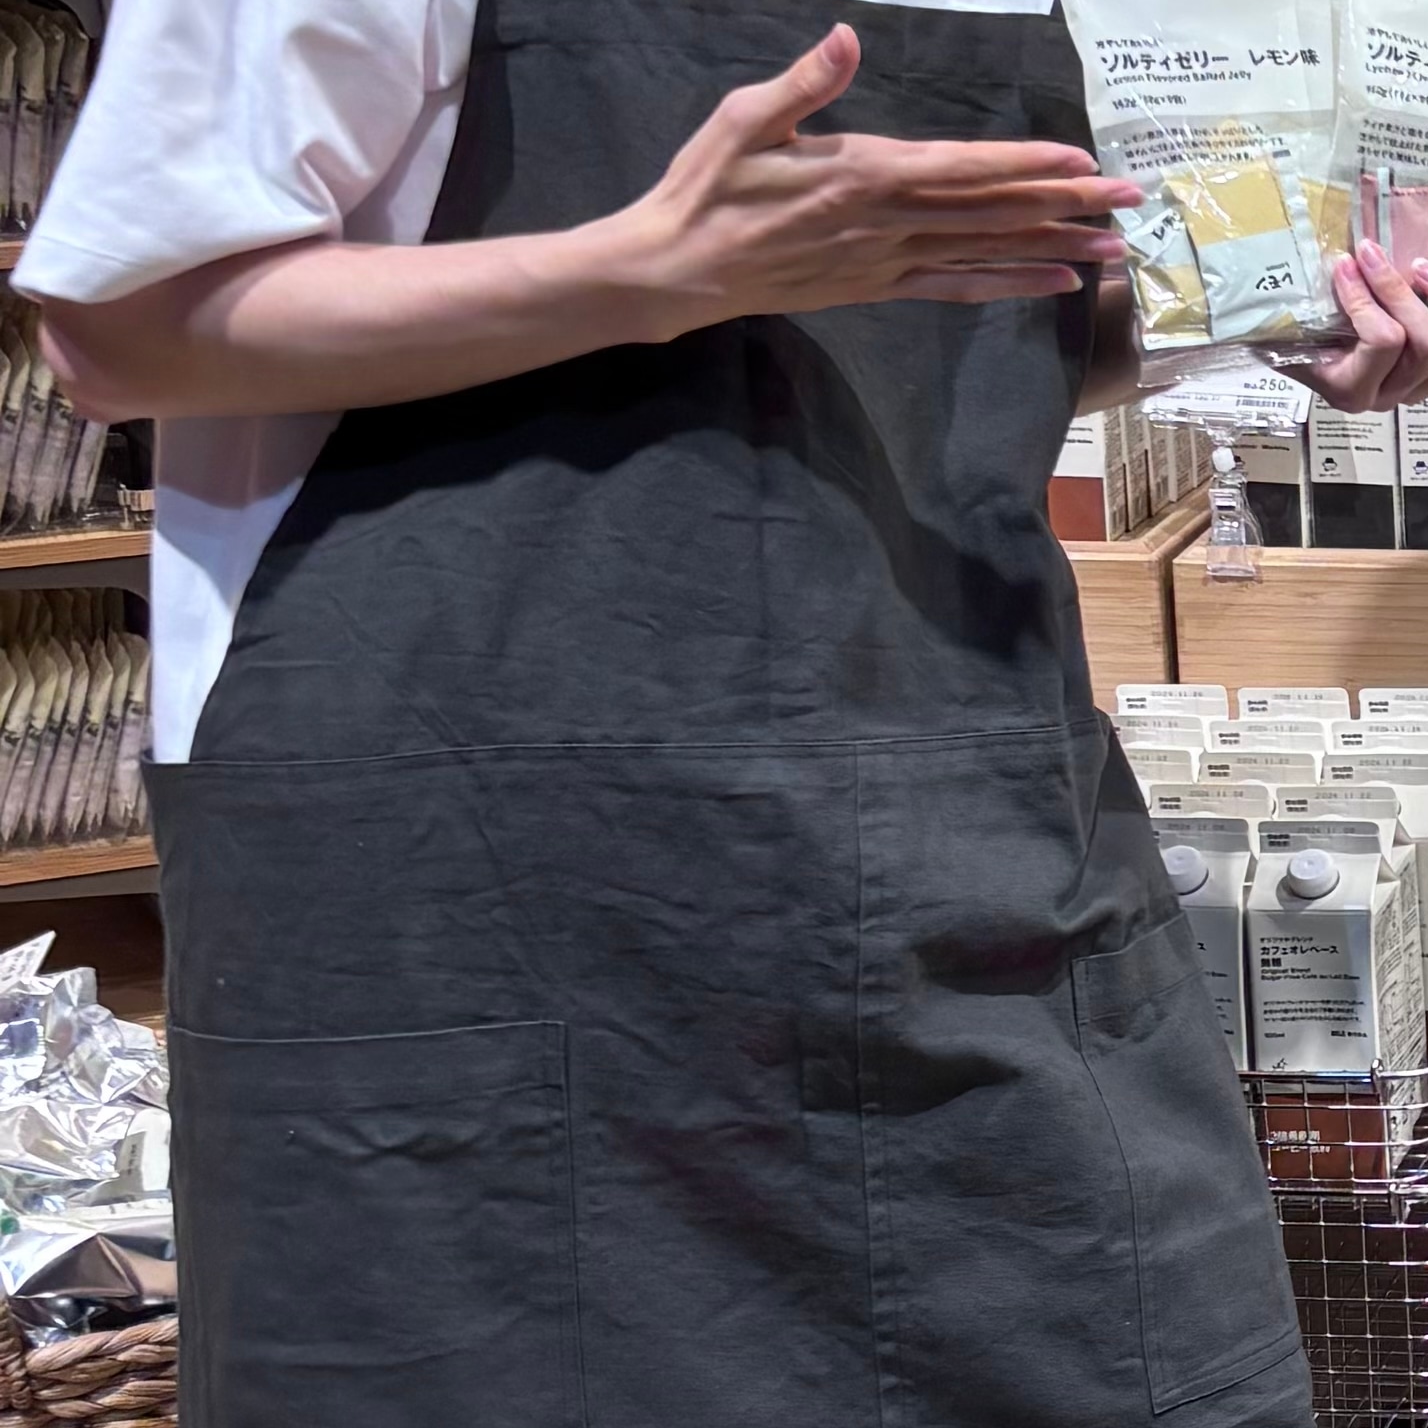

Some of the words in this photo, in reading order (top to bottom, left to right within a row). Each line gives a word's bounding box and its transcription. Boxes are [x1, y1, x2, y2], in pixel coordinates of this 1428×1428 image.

[1101, 51, 1229, 72] ソルティゼリー
[1248, 49, 1320, 66] レモン味
[1259, 378, 1287, 392] 250
[1260, 946, 1339, 955] カフェオレベース
